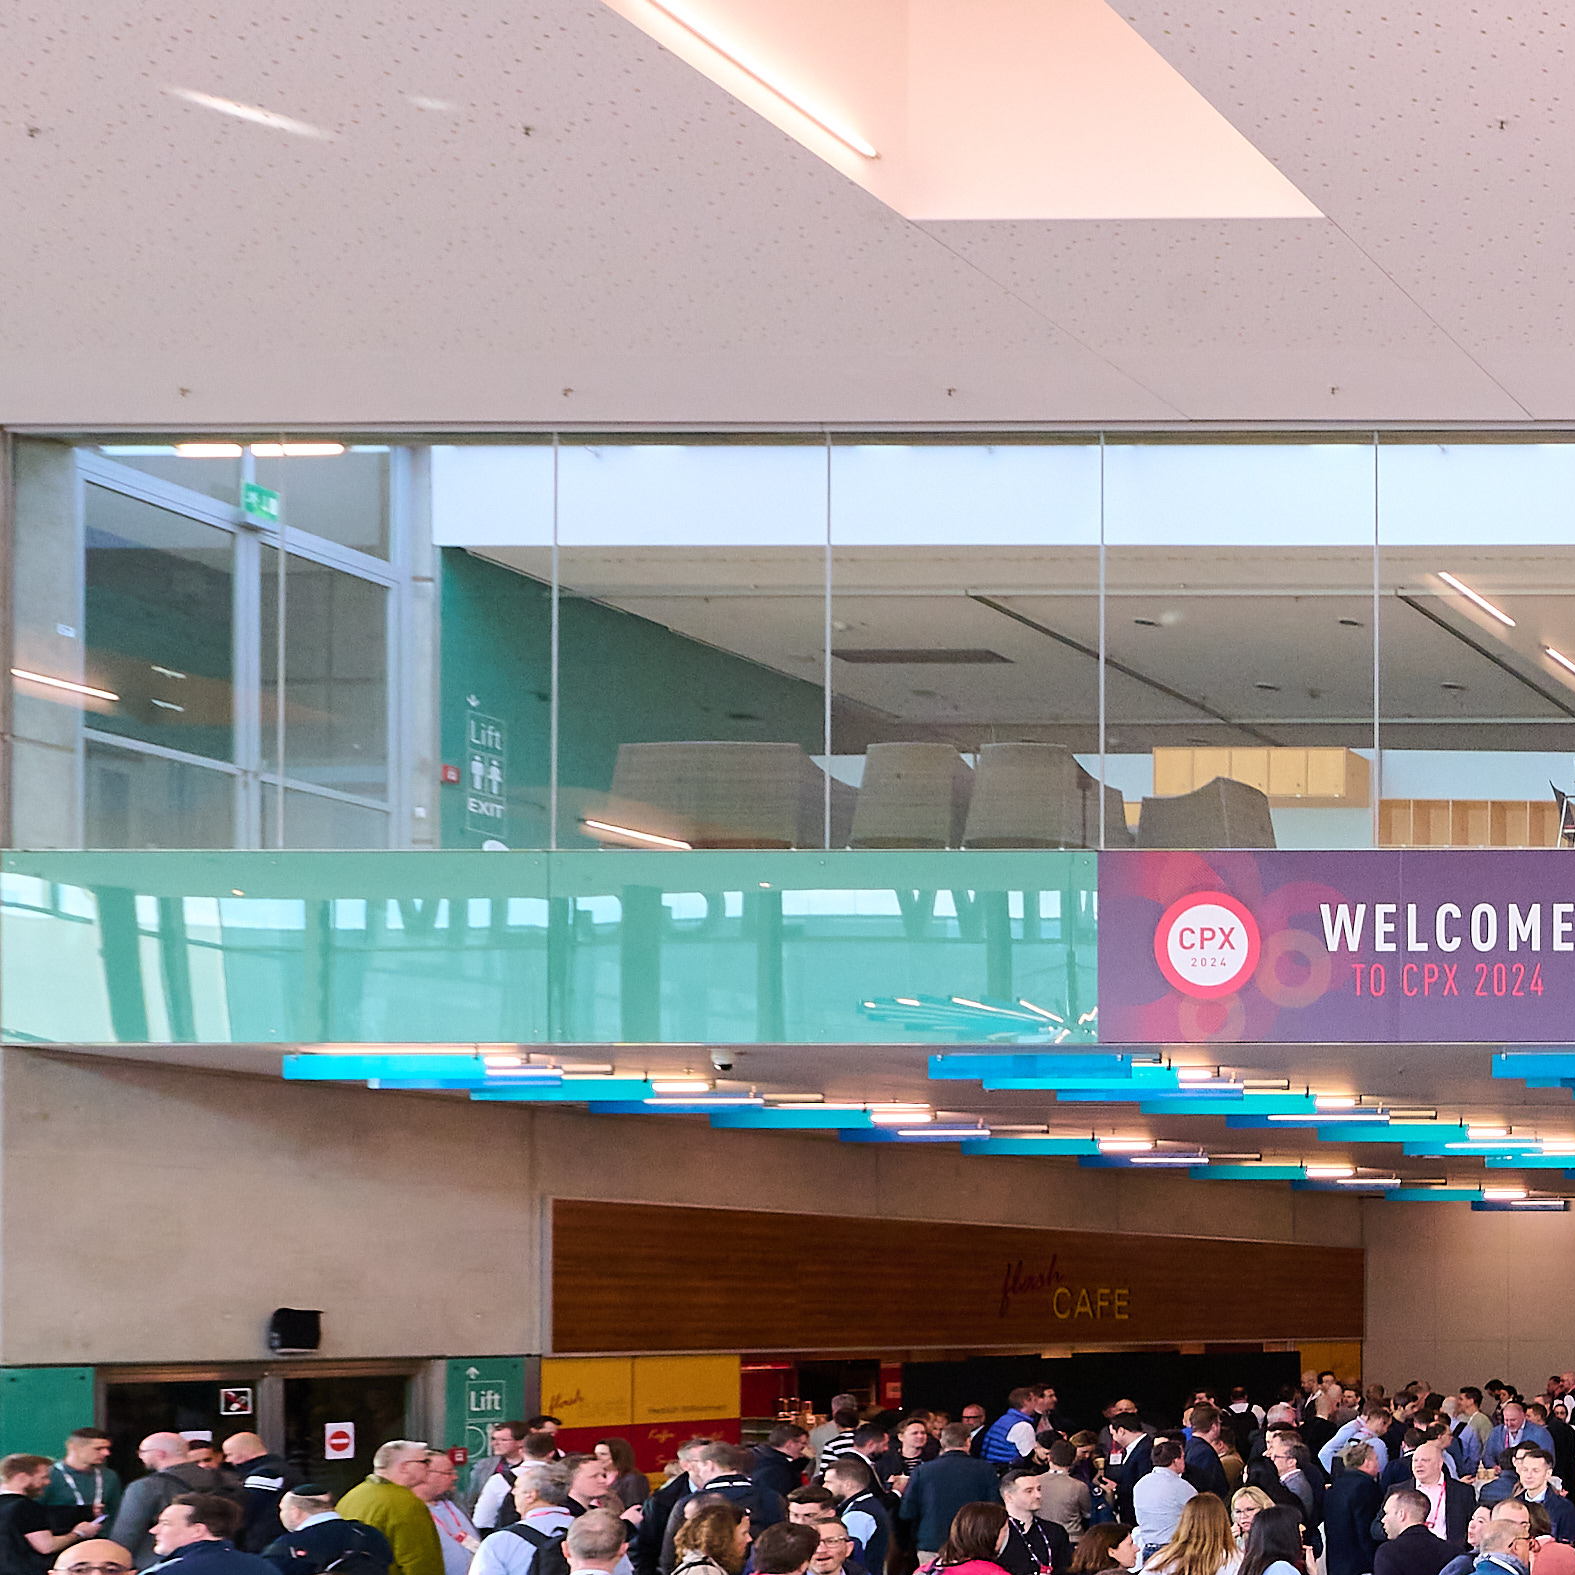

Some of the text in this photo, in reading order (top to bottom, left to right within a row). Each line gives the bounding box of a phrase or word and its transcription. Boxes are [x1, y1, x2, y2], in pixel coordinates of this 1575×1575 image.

[471, 720, 502, 750] Lift
[468, 798, 504, 818] EXIT
[1178, 926, 1236, 950] CPX
[1320, 903, 1575, 952] WELCOME
[1190, 957, 1228, 967] 2024
[1352, 963, 1544, 997] TO CPX 2024
[1001, 1254, 1064, 1318] flash
[1053, 1287, 1129, 1319] CAFE
[470, 1390, 501, 1411] Lift
